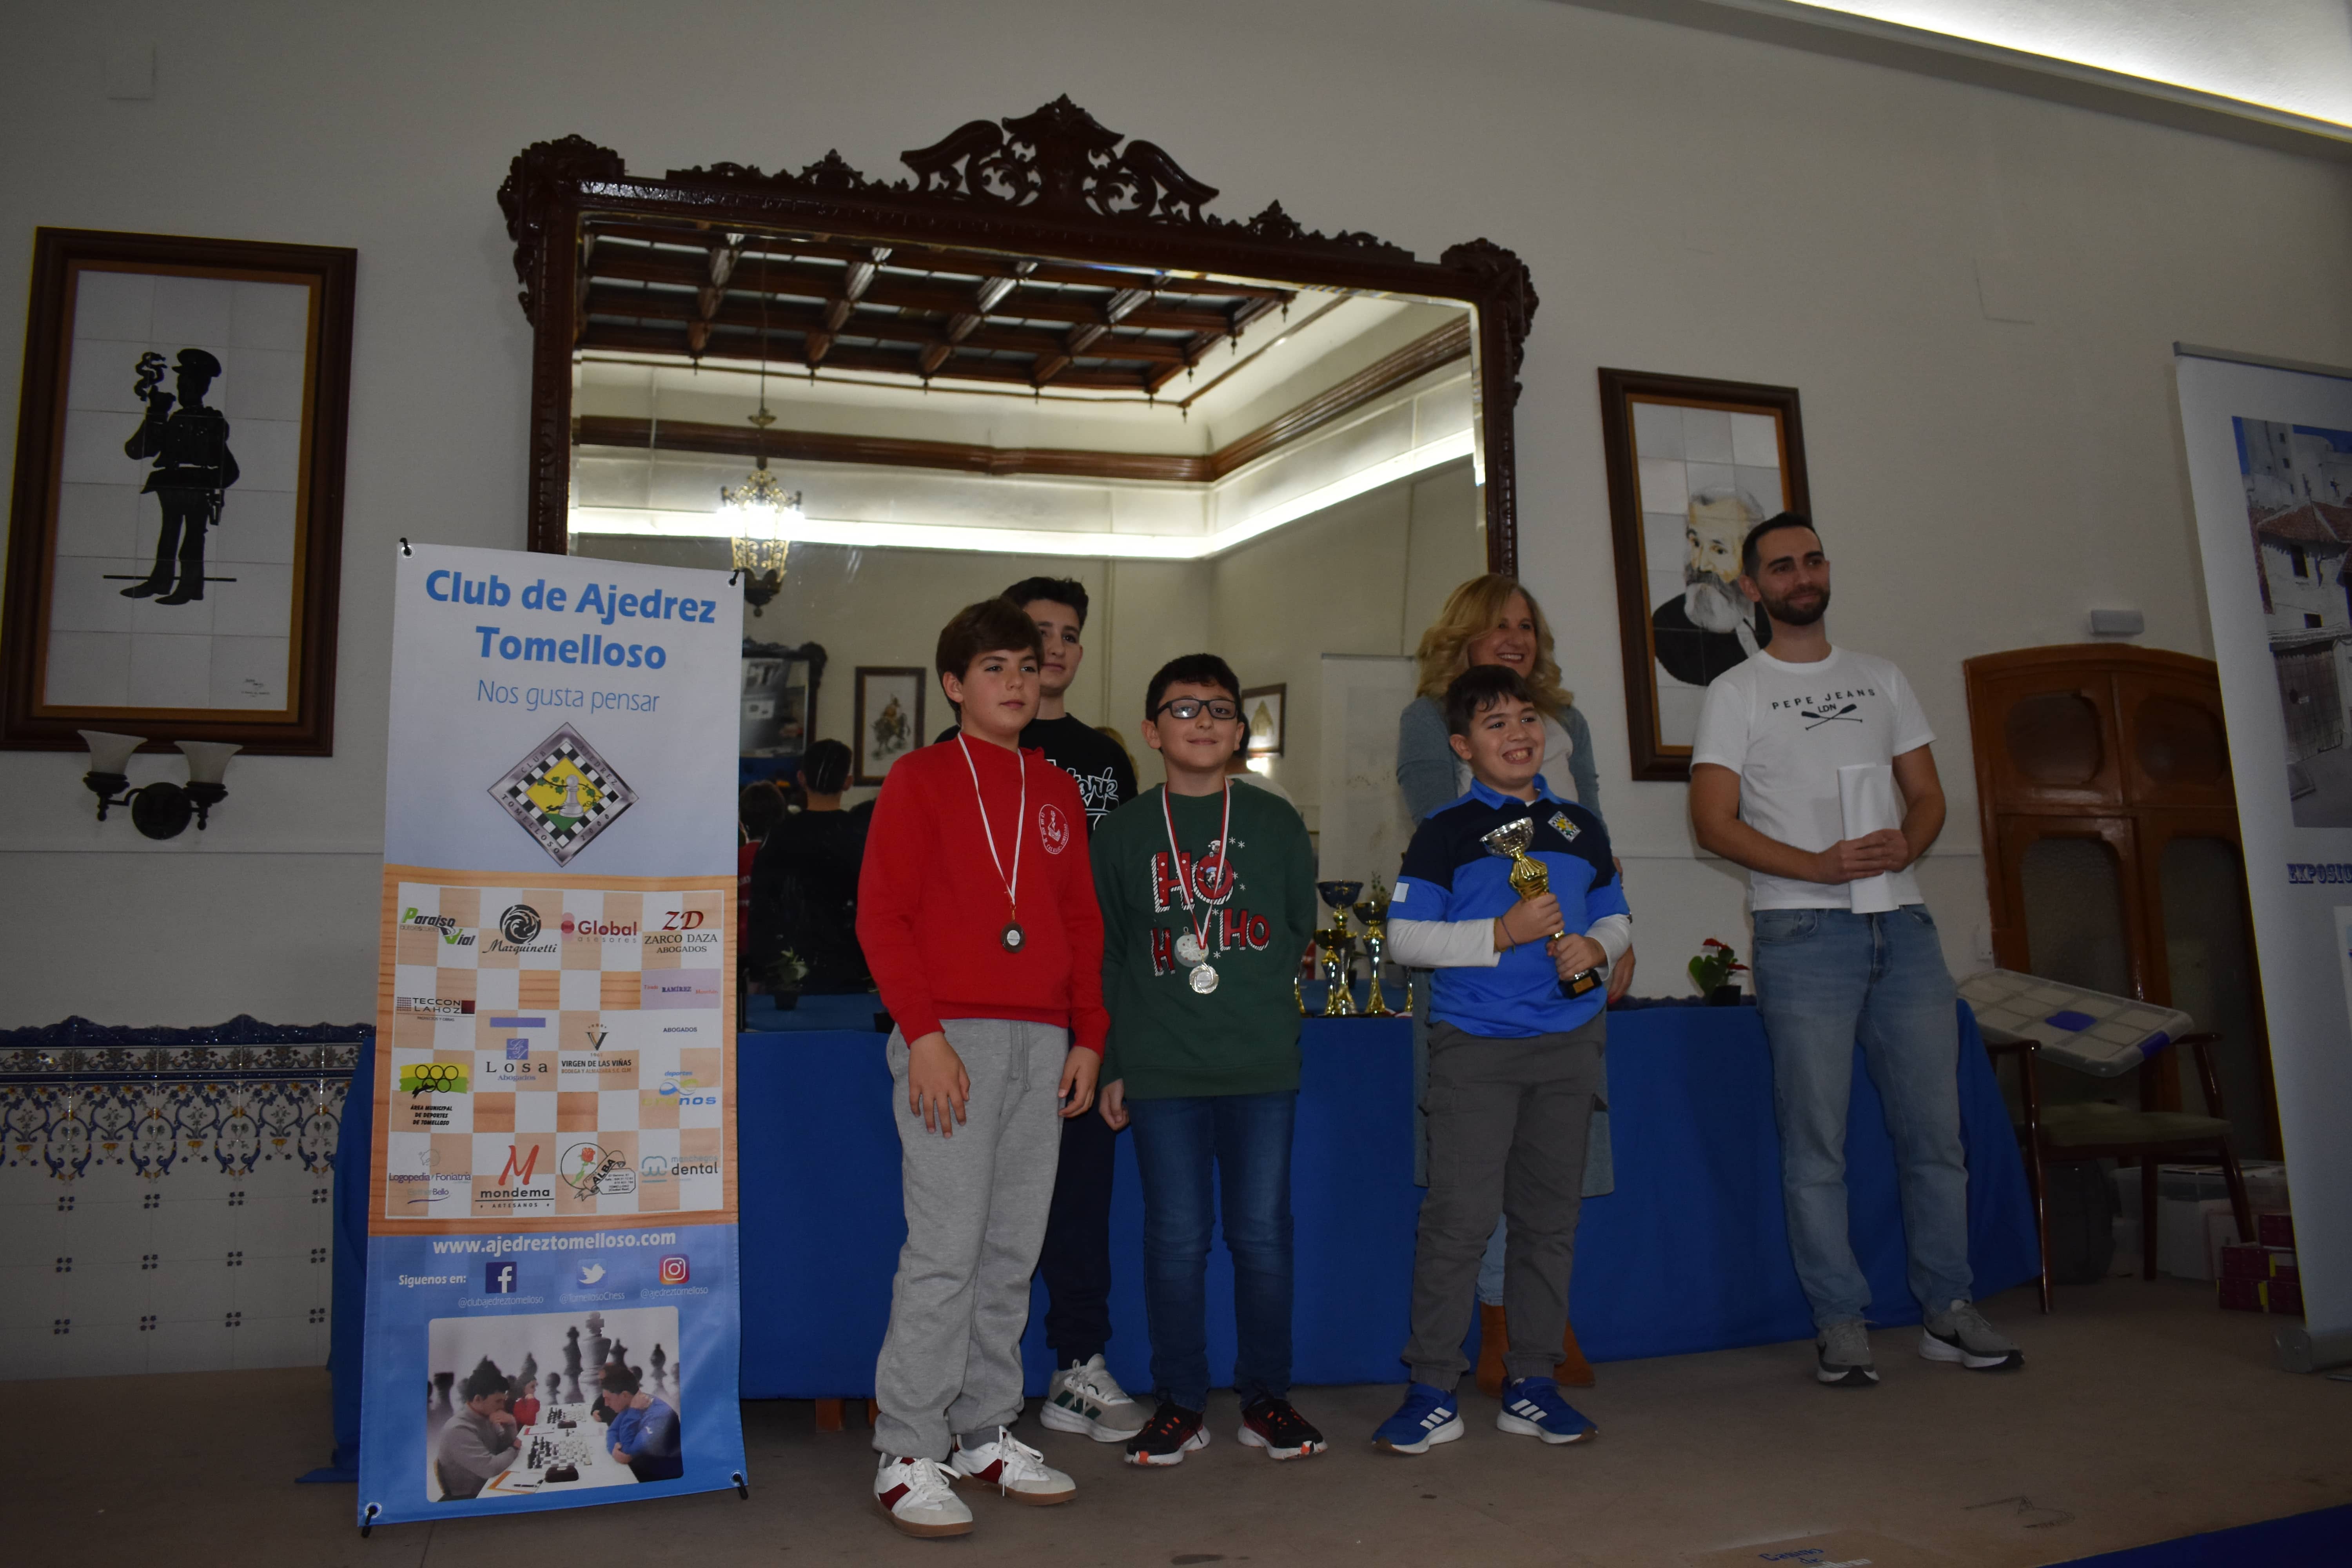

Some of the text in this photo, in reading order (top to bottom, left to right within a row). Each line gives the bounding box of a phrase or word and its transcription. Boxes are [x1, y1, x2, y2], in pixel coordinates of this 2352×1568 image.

[426, 569, 717, 626] Club de Ajedrez
[475, 626, 666, 670] Tomelloso
[477, 680, 660, 714] Nos gusta pensar
[1772, 688, 1875, 710] PEPE JEANS
[1818, 703, 1837, 713] LDN
[521, 750, 546, 773] CLUB
[578, 745, 618, 785] AJEDREZ
[501, 794, 560, 853] TOMELLOSO
[581, 814, 609, 841] 2000
[402, 907, 456, 927] Paraiso
[662, 910, 704, 931] ZD
[441, 927, 476, 946] Vial
[578, 920, 637, 936] Global
[1219, 907, 1270, 951] HO
[482, 939, 557, 955] Marquinetti
[644, 934, 718, 944] ZARCO DAZA
[412, 998, 461, 1006] TECCON
[414, 1005, 460, 1014] LAHOZ
[486, 1061, 548, 1073] Losa
[498, 1145, 540, 1186] M
[592, 1159, 615, 1185] ALBA
[671, 1161, 718, 1175] dental
[389, 1172, 430, 1183] Logopedia
[480, 1187, 550, 1198] mondema
[433, 1232, 676, 1257] www.ajedreztomelloso.com
[398, 1274, 466, 1288] Siguenos en:
[458, 1295, 544, 1308] @clubajedreztomelloso
[559, 1290, 625, 1305] @TomellosoChess
[641, 1285, 709, 1299] @ajedreztomelloso
